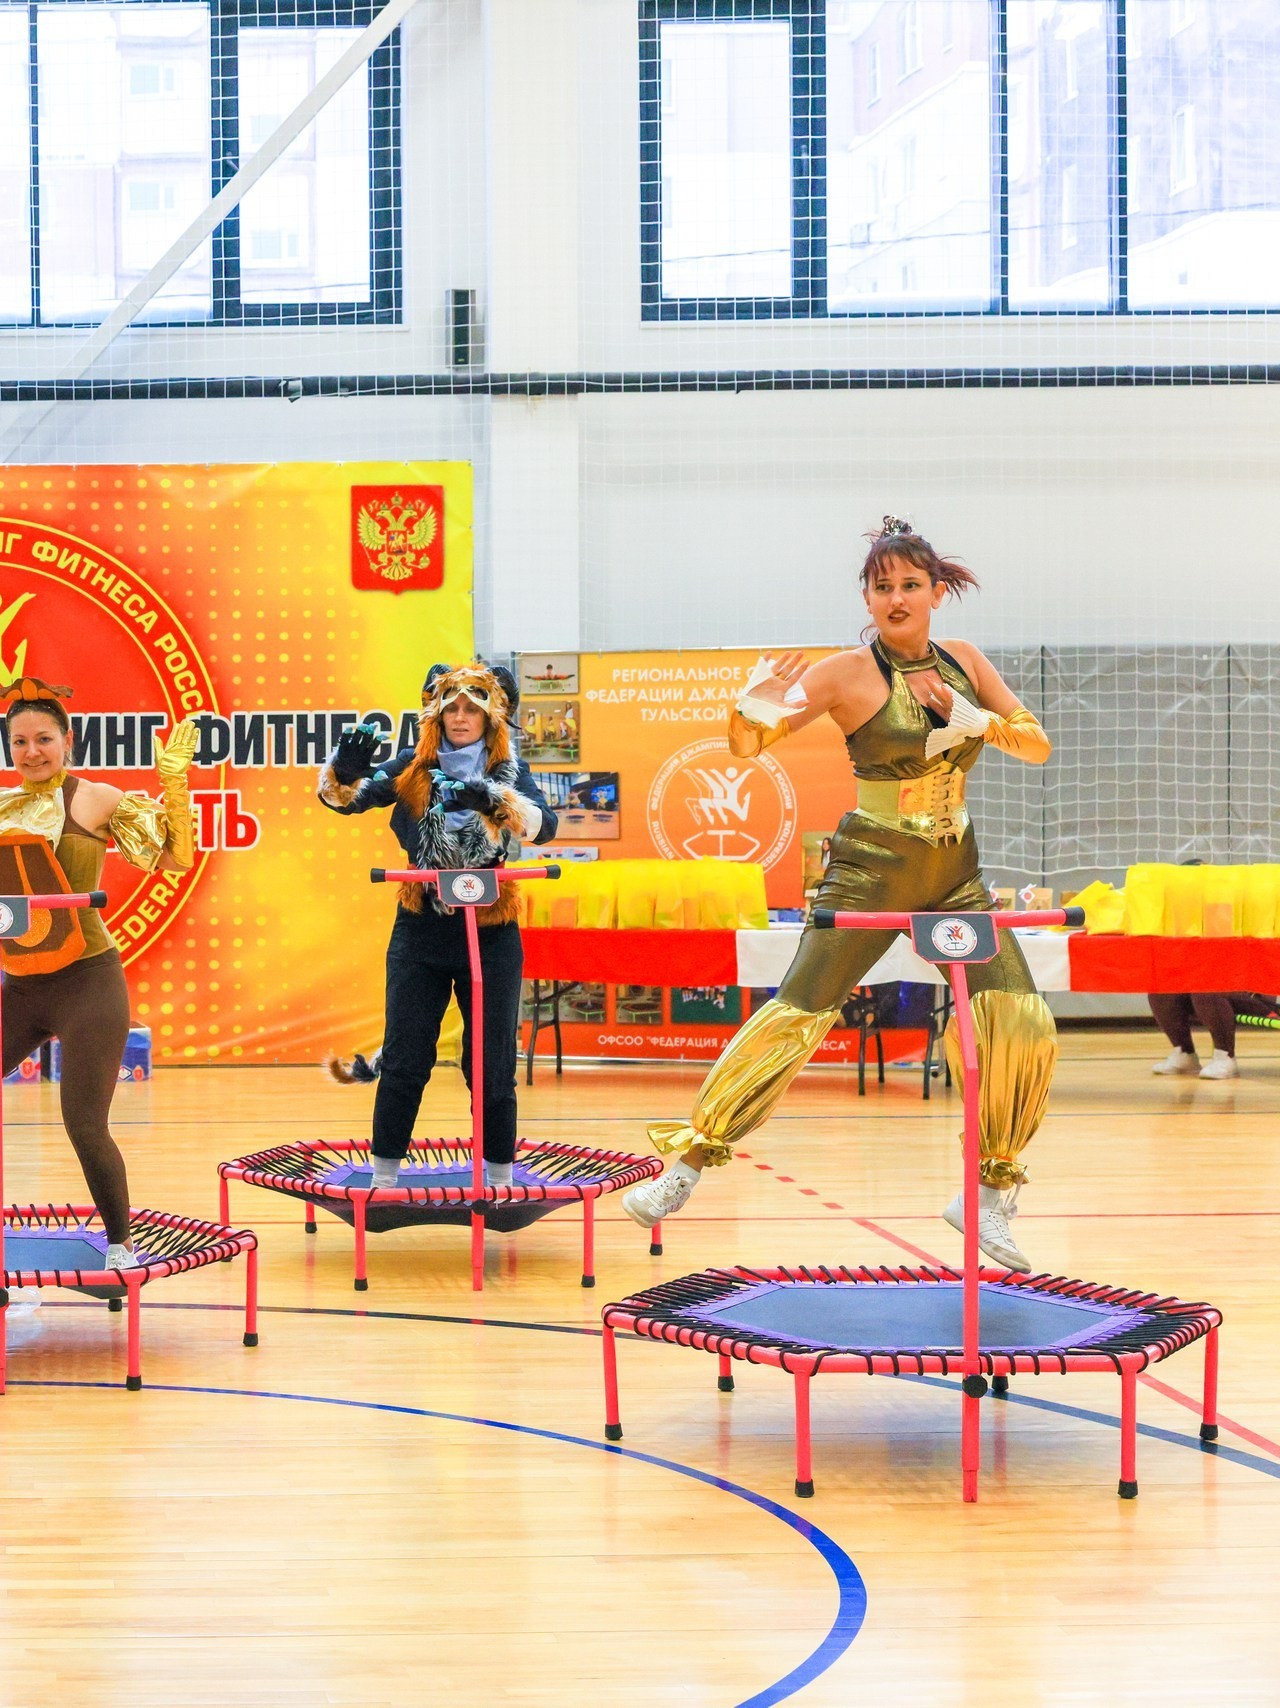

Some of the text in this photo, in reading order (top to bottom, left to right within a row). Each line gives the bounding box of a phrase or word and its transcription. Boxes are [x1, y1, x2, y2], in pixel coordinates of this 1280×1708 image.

[31, 540, 159, 635] ФИТНЕСА
[153, 631, 207, 715] РОСС
[612, 666, 741, 683] РЕГИОНАЛЬНОЕ
[585, 686, 743, 704] ФЕДЕРАЦИИ ДЖАМ
[640, 705, 728, 722] ТУЛЬСКОЙ
[680, 741, 730, 762] ДЖАМПИН
[757, 754, 777, 773] НЕСА
[775, 772, 793, 810] РОССИИ
[762, 820, 793, 868] EDERATION
[111, 869, 187, 954] EDERA
[597, 1034, 644, 1046] ОФСОО
[646, 1035, 719, 1048] "ФЕДЕРАЦИЯ
